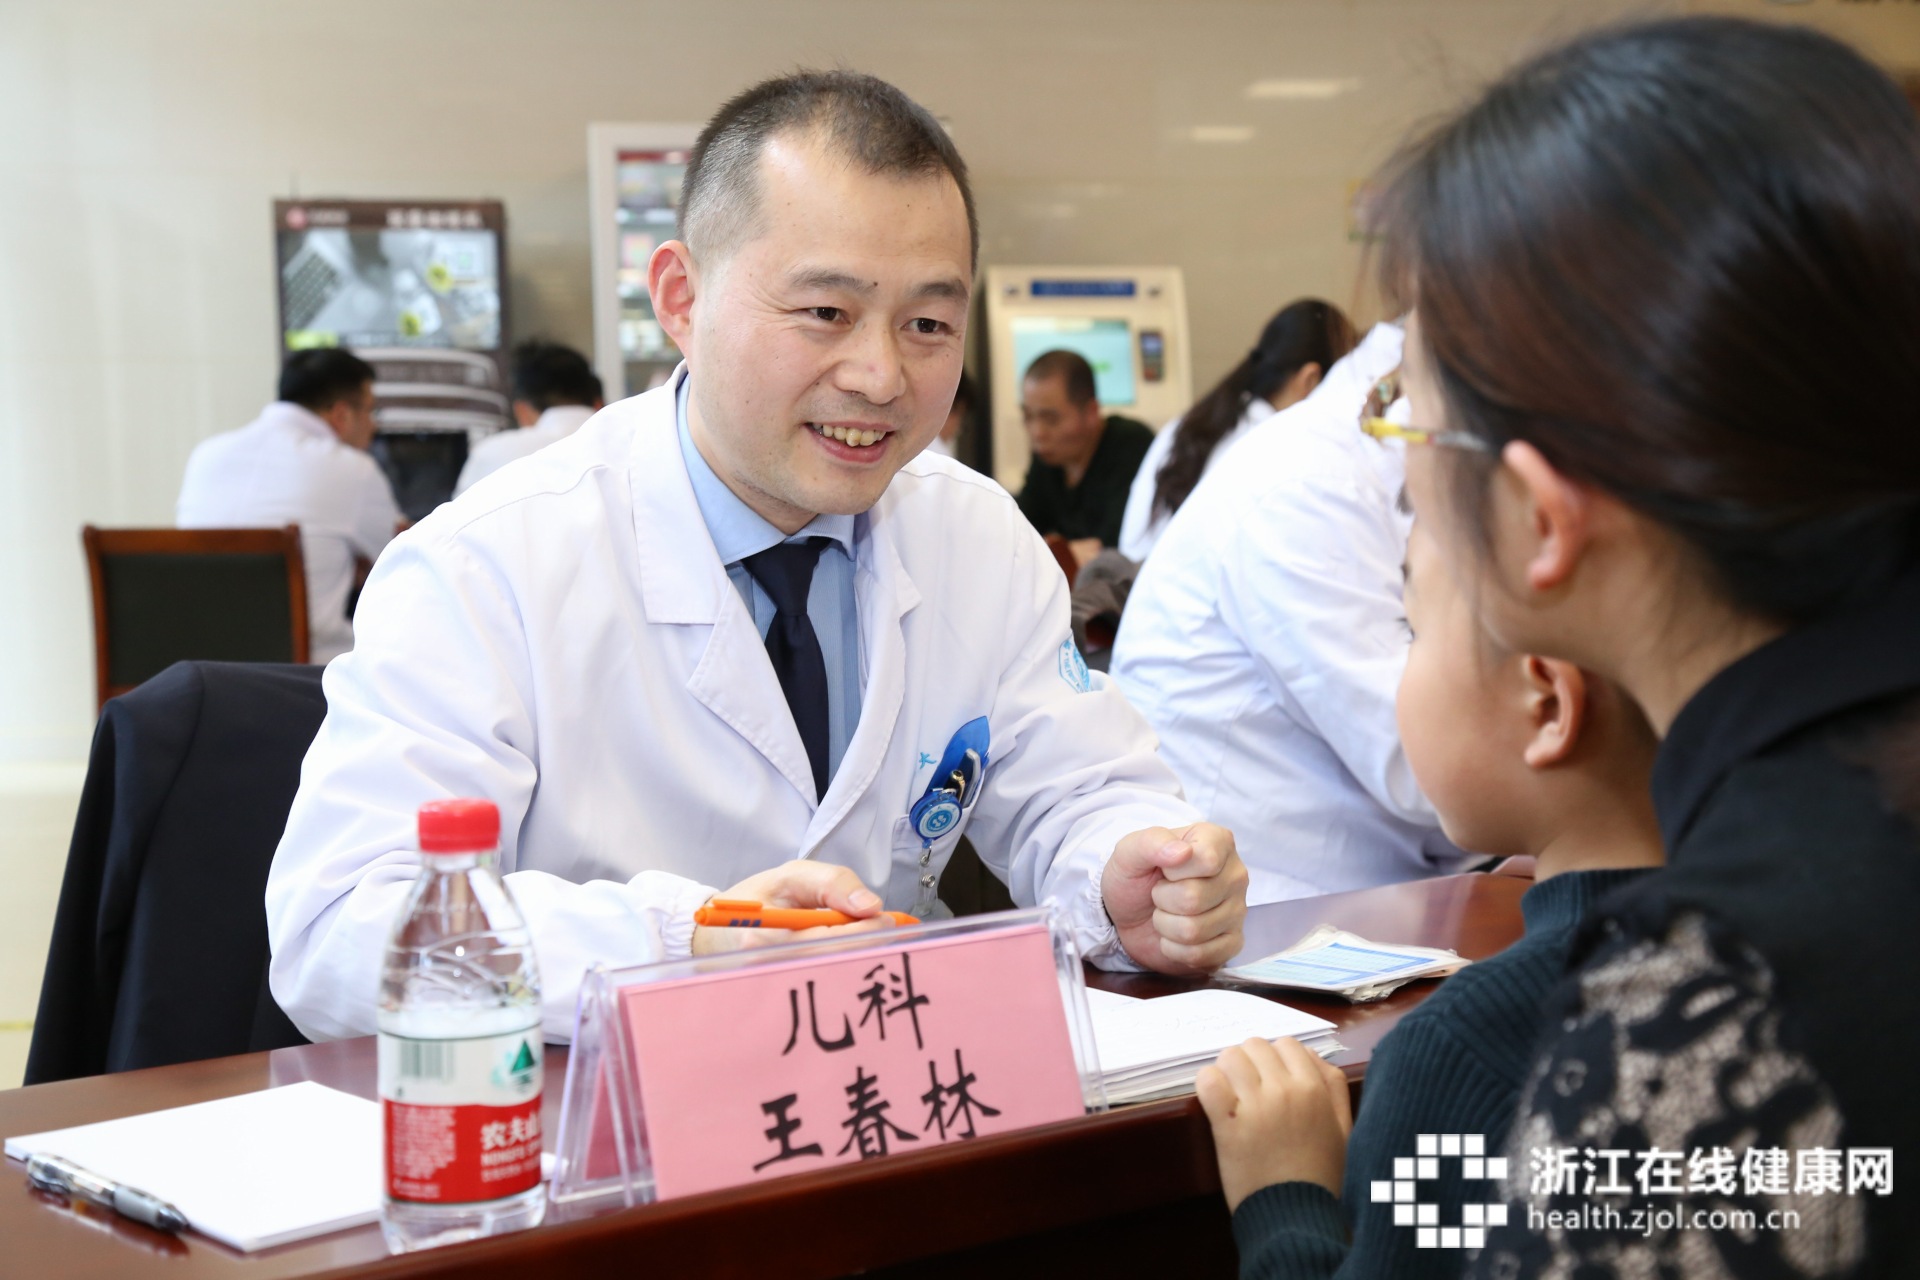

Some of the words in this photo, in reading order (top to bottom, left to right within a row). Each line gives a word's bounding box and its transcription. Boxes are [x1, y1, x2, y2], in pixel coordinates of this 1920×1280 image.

[782, 951, 930, 1056] 儿科
[753, 1049, 1002, 1173] 王春林
